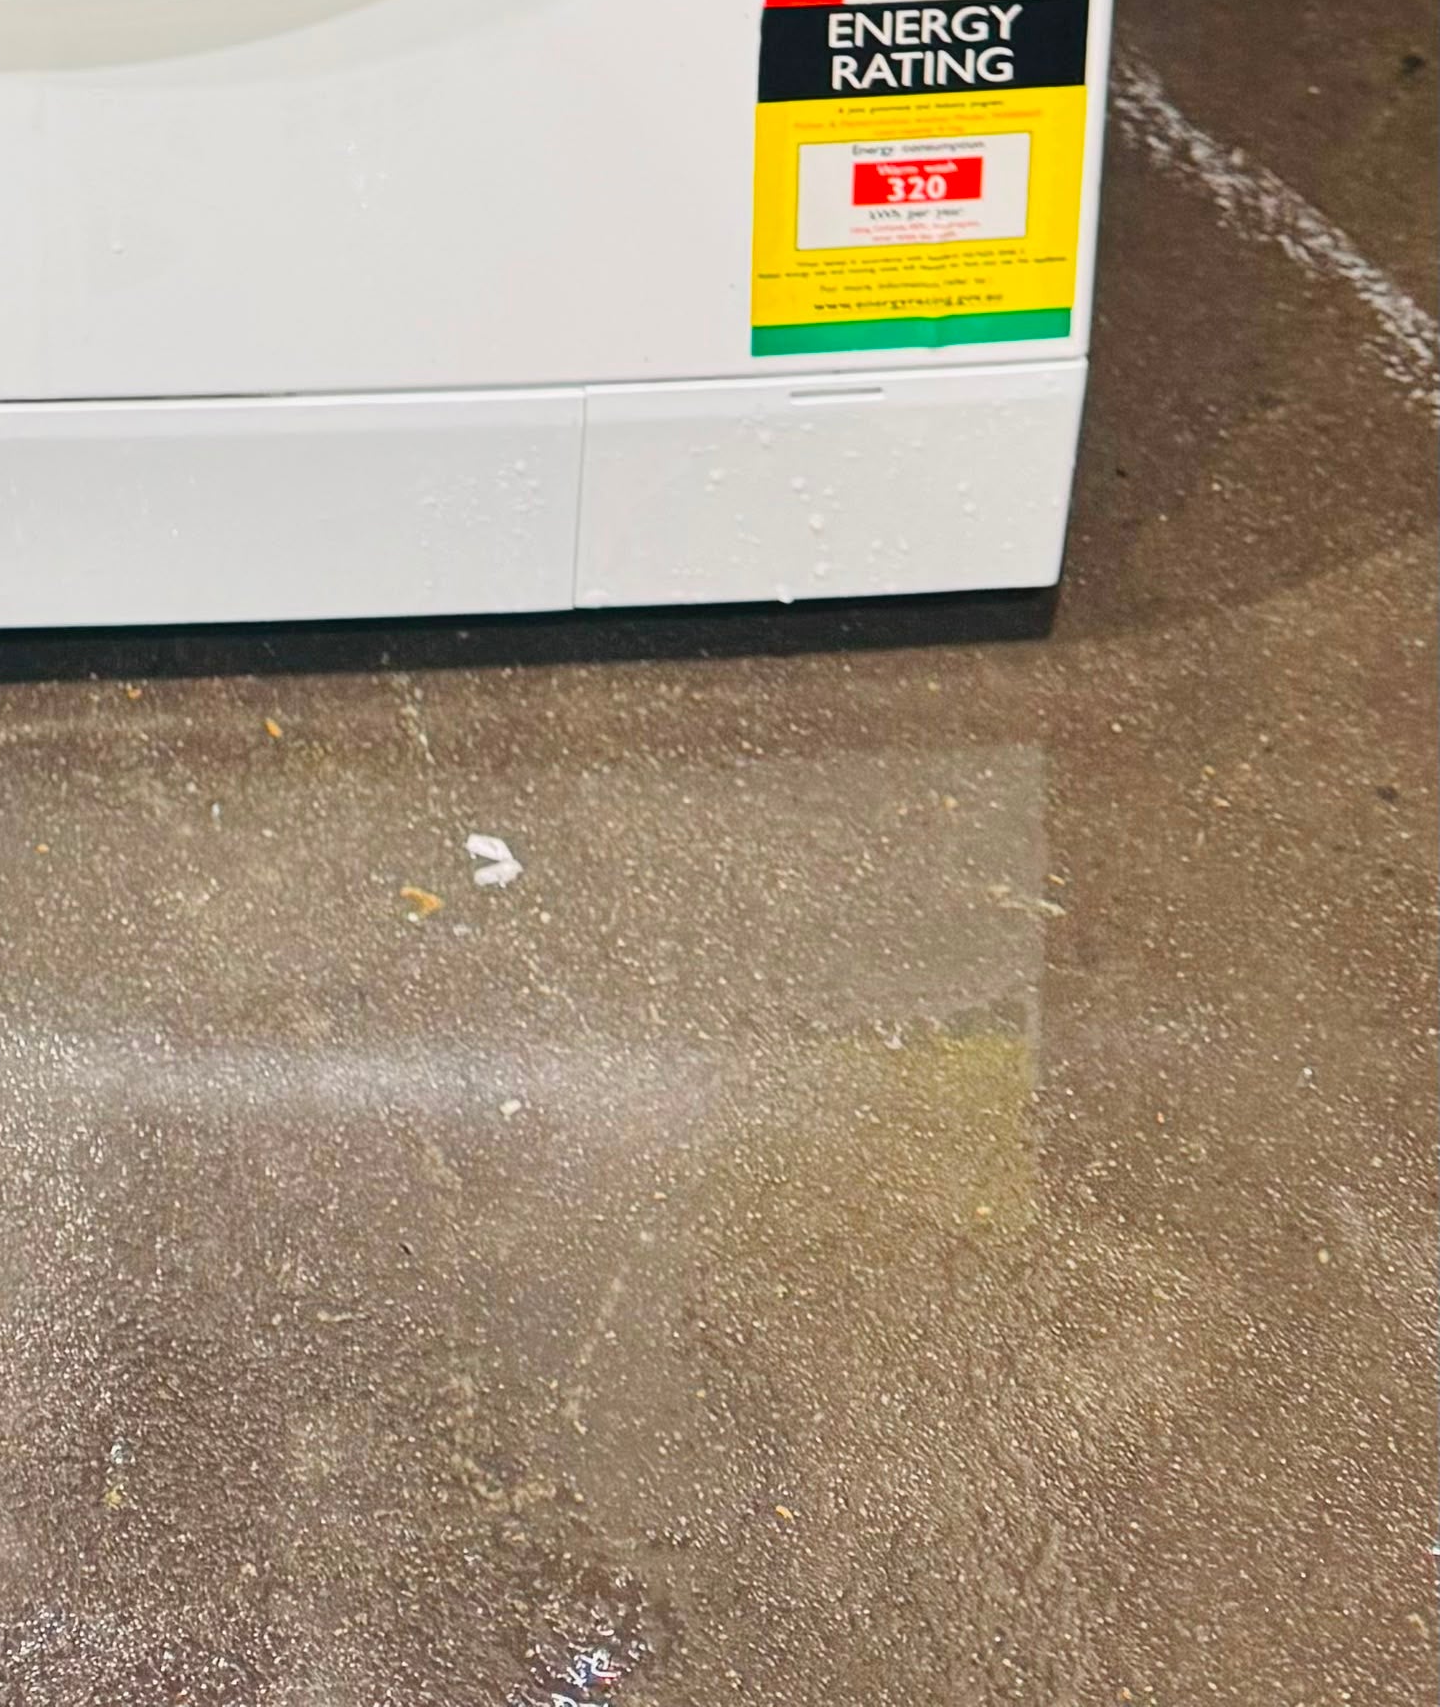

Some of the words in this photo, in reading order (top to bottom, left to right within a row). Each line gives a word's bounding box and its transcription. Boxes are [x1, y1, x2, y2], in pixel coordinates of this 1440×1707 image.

[828, 4, 1023, 50] ENERGY
[831, 46, 1014, 91] RATING
[887, 174, 947, 202] 320
